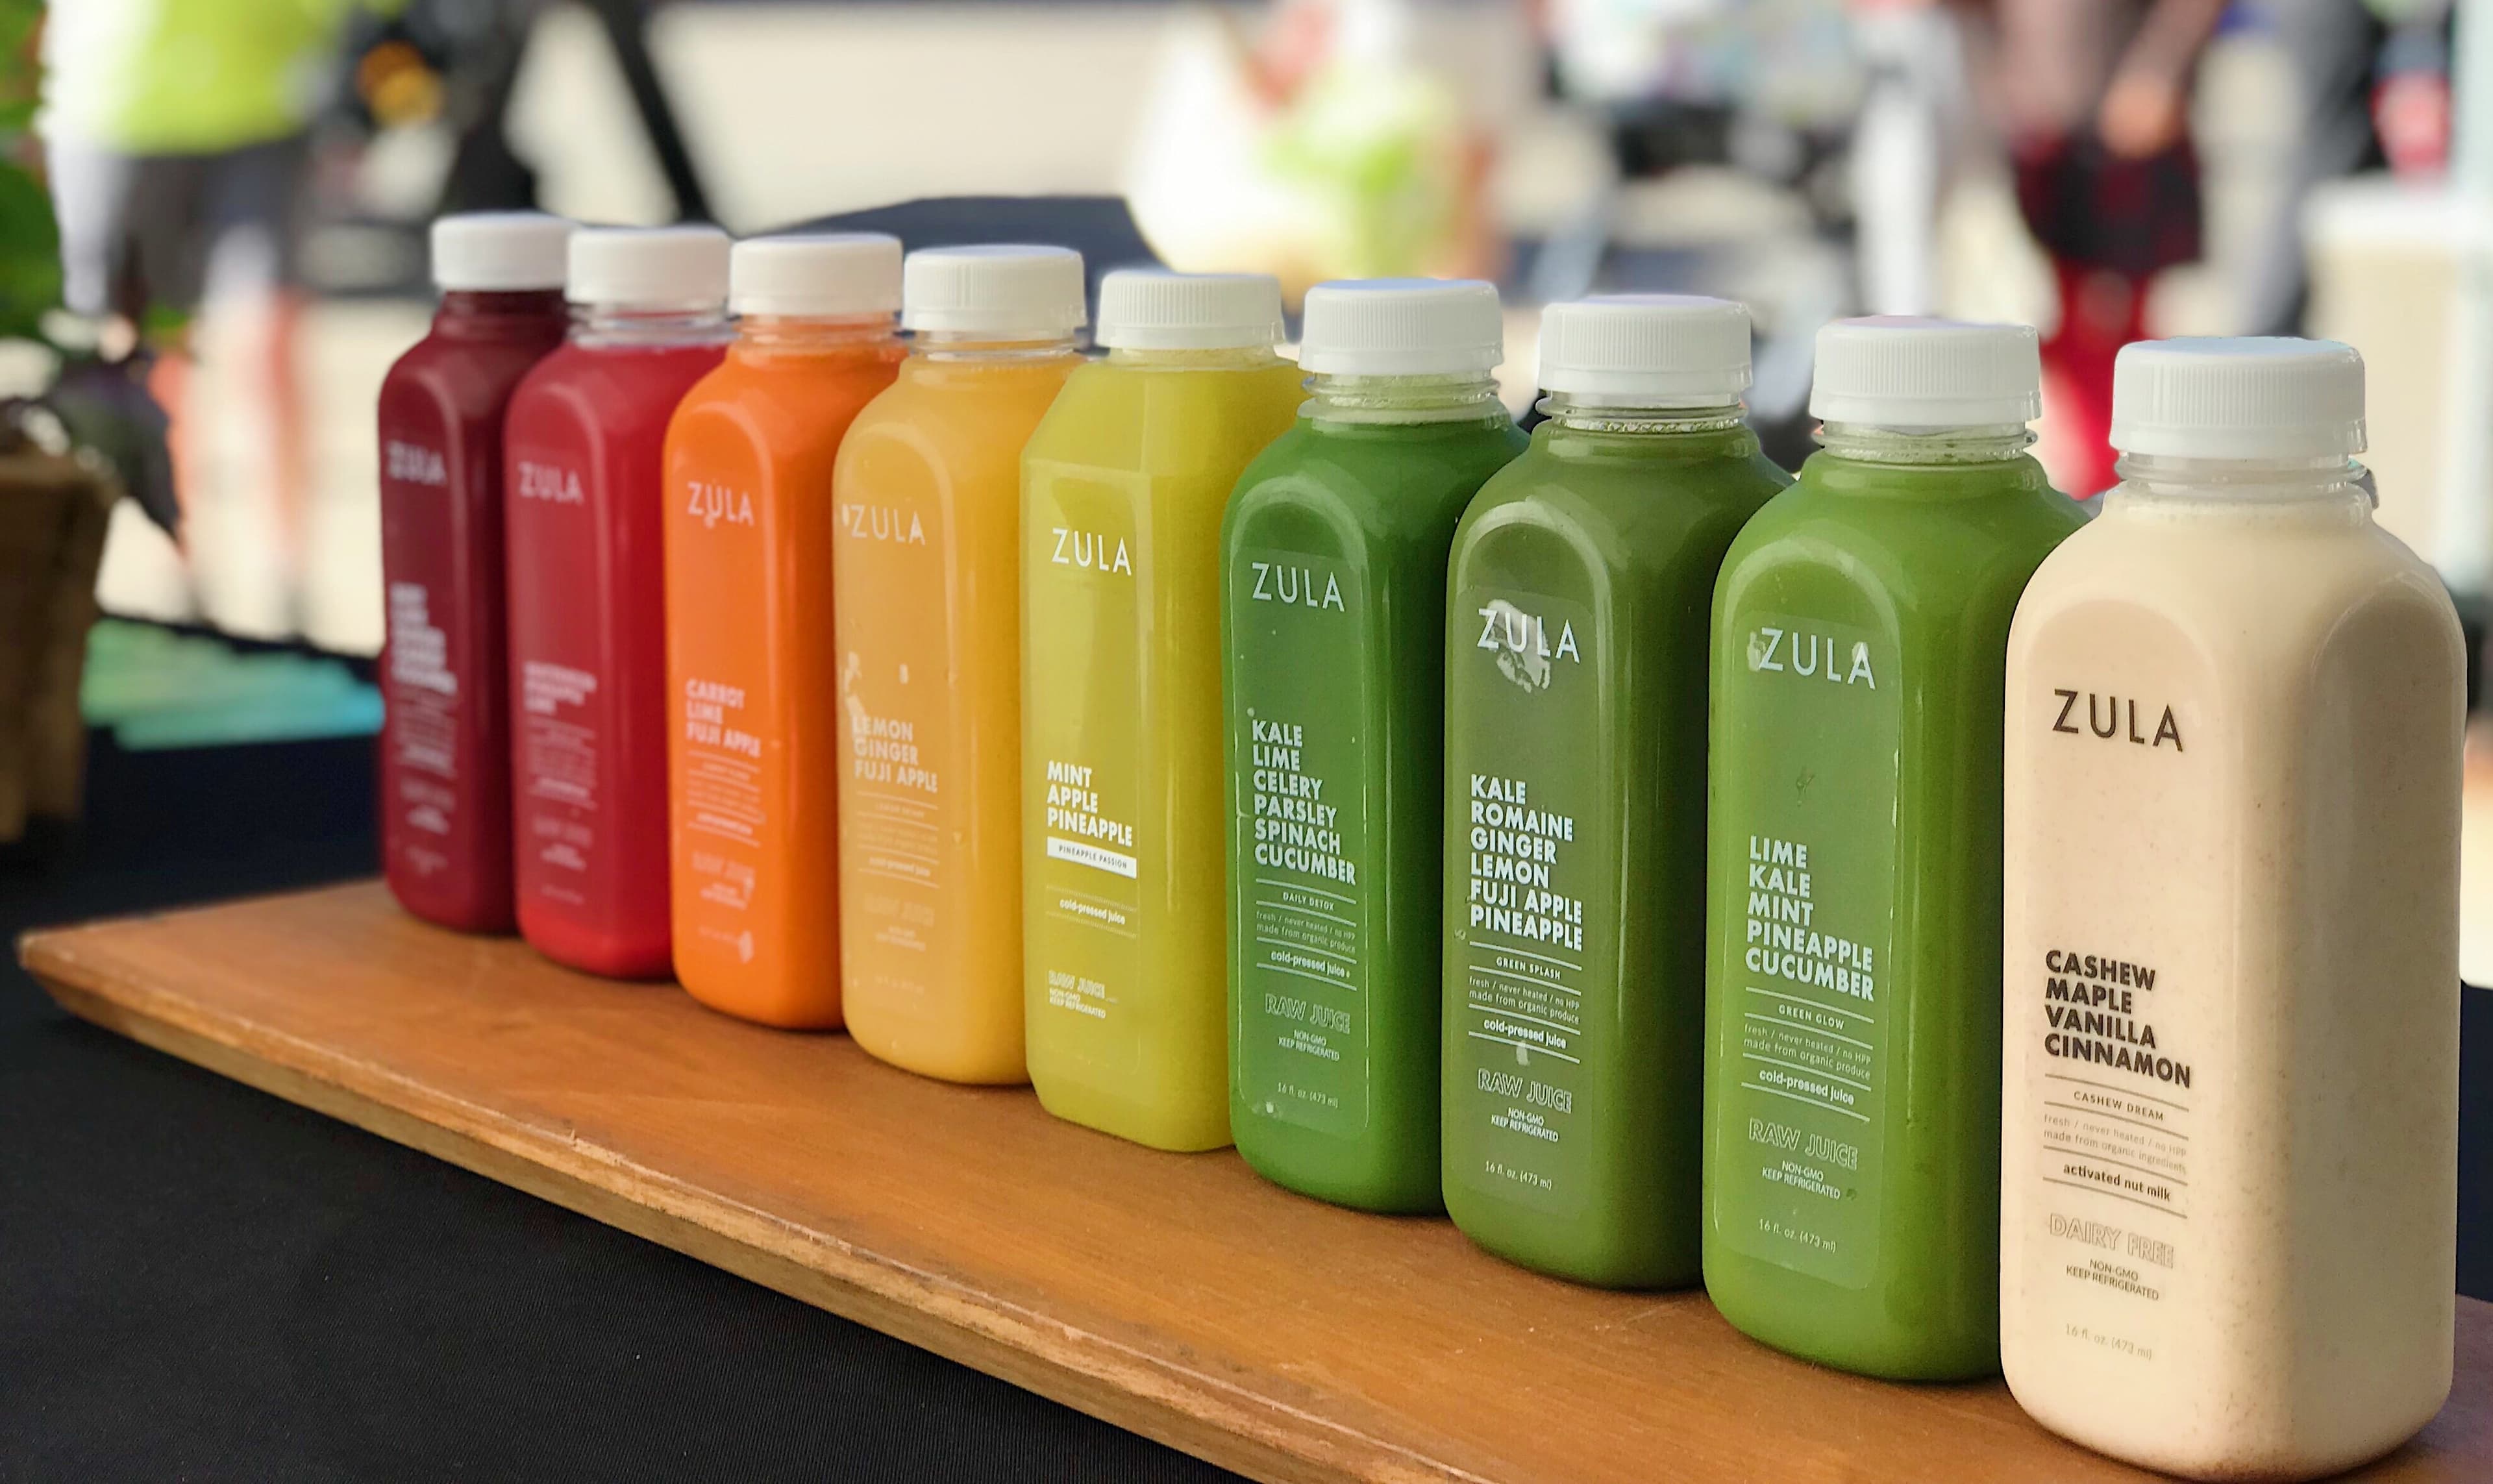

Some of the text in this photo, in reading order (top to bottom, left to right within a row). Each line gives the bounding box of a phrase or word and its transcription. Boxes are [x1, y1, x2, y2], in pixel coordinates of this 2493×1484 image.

[519, 462, 582, 503] ZULA
[687, 481, 754, 527] ZULA
[850, 504, 925, 545] ZULA
[1052, 527, 1132, 576] ZULA
[1252, 562, 1345, 612] ZULA
[1477, 608, 1580, 664] ZULA
[1759, 627, 1876, 689] ZULA
[852, 716, 913, 741] LEMON
[1252, 719, 1302, 748] KALE
[2052, 688, 2183, 753] ZULA
[853, 738, 918, 765] GINGER
[1253, 744, 1300, 771] LIME
[854, 760, 937, 793] FUJI APPLE
[1047, 760, 1092, 788] MINT
[1253, 769, 1323, 801] CELERY
[1470, 773, 1526, 806] KALE
[1047, 784, 1098, 814] APPLE
[1254, 794, 1337, 828] PARSLEY
[1047, 806, 1133, 847] PINEAPPLE
[1254, 818, 1341, 856] SPINACH
[1470, 800, 1574, 843] ROMAINE
[1059, 845, 1127, 869] PINEAPPLE PASSION
[1470, 826, 1557, 864] GINGER
[1750, 835, 1807, 869] LIME
[1254, 843, 1356, 885] CUCUMBER
[1470, 852, 1550, 889] LEMON
[1749, 863, 1811, 899] KALE
[1060, 898, 1125, 924] cold-pressed juice
[1283, 891, 1335, 911] DAILY DETOX
[1470, 878, 1583, 926] FUJI APPLE
[1747, 891, 1813, 928] MINT
[1256, 911, 1276, 922] fresh
[1285, 917, 1304, 926] never
[1306, 920, 1328, 934] heated
[1256, 923, 1356, 954] made from organic produce
[1470, 904, 1583, 952] PINEAPPLE
[1271, 950, 1345, 978] cold-pressed juice
[1747, 919, 1873, 973] PINEAPPLE
[1496, 956, 1561, 980] GREEN SPLASH
[1746, 948, 1874, 1002] CUCUMBER
[2046, 949, 2155, 991] CASHEW
[1469, 976, 1489, 989] fresh
[1499, 983, 1520, 995] never
[1522, 987, 1548, 1002] heated
[1565, 998, 1580, 1010] HPP
[1469, 989, 1580, 1024] made from organic produce
[2045, 977, 2132, 1015] MAPLE
[1265, 993, 1350, 1034] RAW JUICE
[1778, 1004, 1844, 1030] GREEN GLOW
[2044, 1004, 2157, 1050] VANILLA
[1278, 1037, 1340, 1061] KEEP REFRIGERATED
[1294, 1030, 1326, 1046] NON-GMO
[1483, 1019, 1567, 1049] cold-pressed juice
[1744, 1023, 1768, 1037] fresh
[1778, 1032, 1802, 1045] never
[1805, 1037, 1833, 1054] heated
[1842, 1050, 1853, 1059] no
[1855, 1052, 1871, 1065] HPP
[1744, 1038, 1870, 1080] made from organic produce
[2044, 1033, 2191, 1089] CINNAMON
[1278, 1082, 1287, 1094] 16
[1478, 1068, 1572, 1114] RAW JUICE
[1759, 1069, 1854, 1106] cold-pressed juice
[2074, 1090, 2164, 1121] CASHEW DREAM
[1491, 1114, 1559, 1143] KEEP REFRIGERATED
[1508, 1107, 1544, 1127] NON-GMO
[2044, 1113, 2070, 1128] fresh
[2083, 1122, 2109, 1135] never
[2114, 1128, 2144, 1145] heated
[2155, 1141, 2166, 1152] no
[2169, 1144, 2187, 1157] HPP
[1749, 1117, 1858, 1170] RAW JUICE
[2044, 1130, 2187, 1176] made from organic ingredients
[1485, 1160, 1495, 1174] 16
[1520, 1170, 1537, 1186] (473
[1540, 1179, 1552, 1191] ml)
[1762, 1167, 1841, 1200] KEEP REFRIGERATED
[1782, 1160, 1824, 1182] NON-GMO
[2063, 1163, 2171, 1202] activated nut milk
[1759, 1218, 1770, 1232] 16
[1800, 1231, 1820, 1248] (473
[1822, 1241, 1837, 1254] ml)
[2050, 1213, 2174, 1269] DAIRY FREE
[2066, 1265, 2159, 1301] KEEP REFRIGERATED
[2090, 1258, 2139, 1281] NON-GMO
[2066, 1323, 2078, 1337] 16
[2111, 1337, 2134, 1354] (473
[2137, 1348, 2152, 1361] ml)
